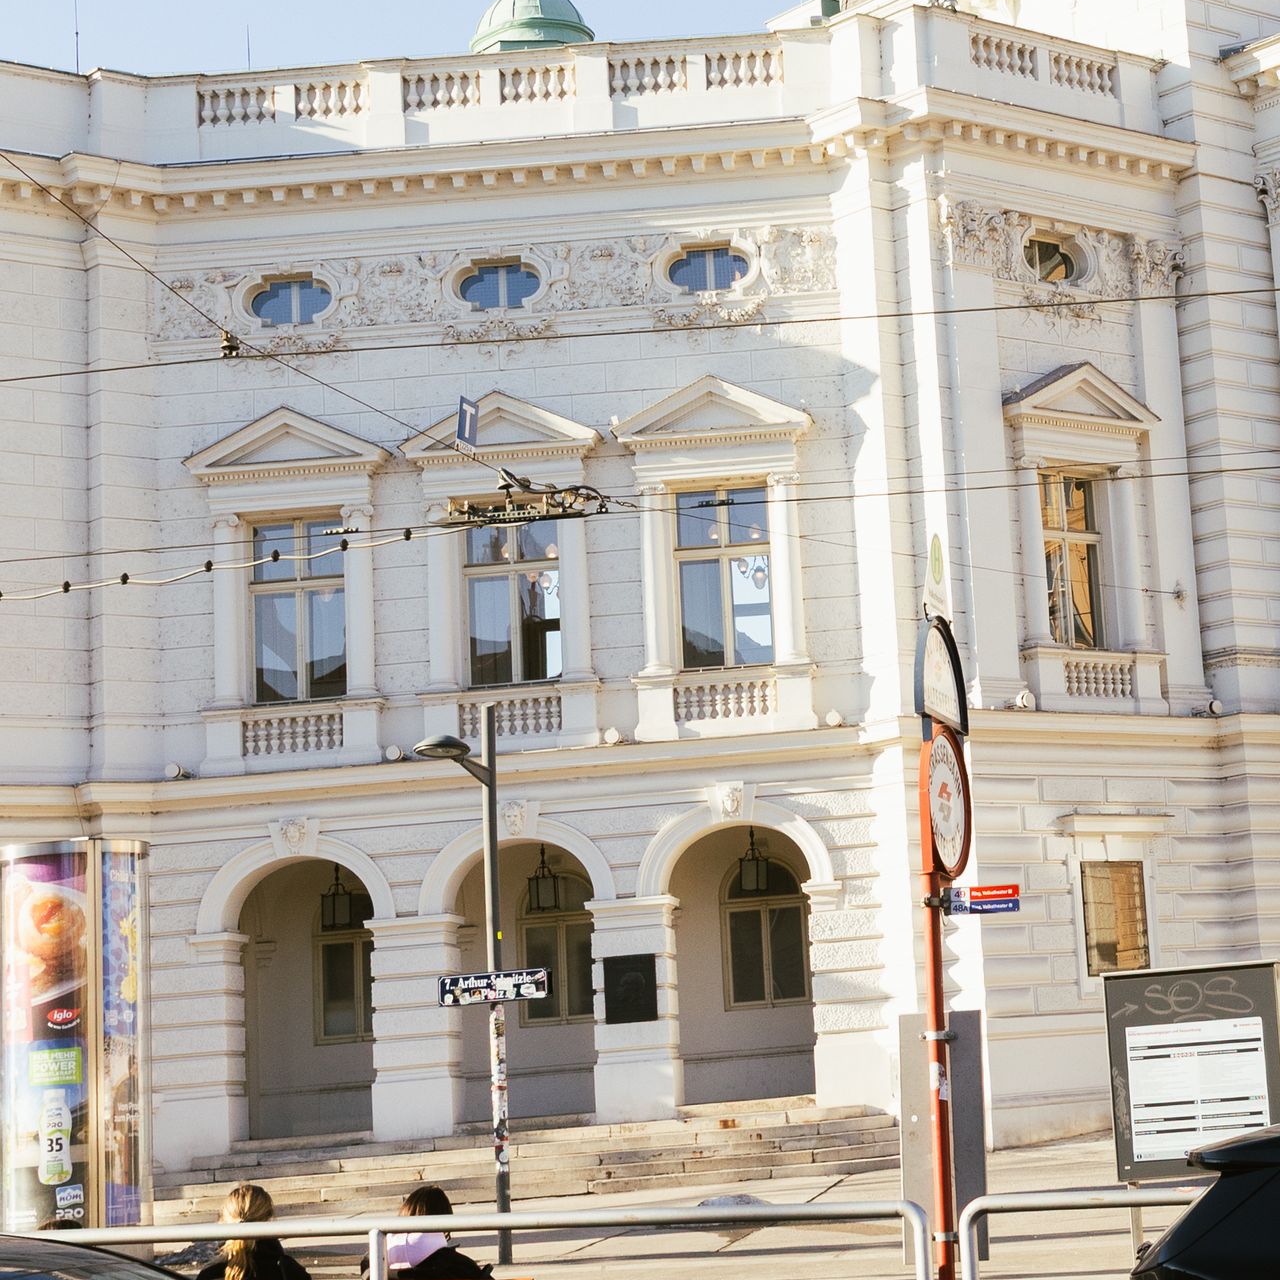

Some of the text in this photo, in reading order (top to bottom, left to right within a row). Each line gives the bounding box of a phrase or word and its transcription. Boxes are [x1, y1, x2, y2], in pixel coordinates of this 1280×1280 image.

[462, 402, 476, 439] T
[53, 1009, 73, 1022] iglo
[47, 1137, 63, 1153] 35
[55, 1207, 84, 1219] PRO
